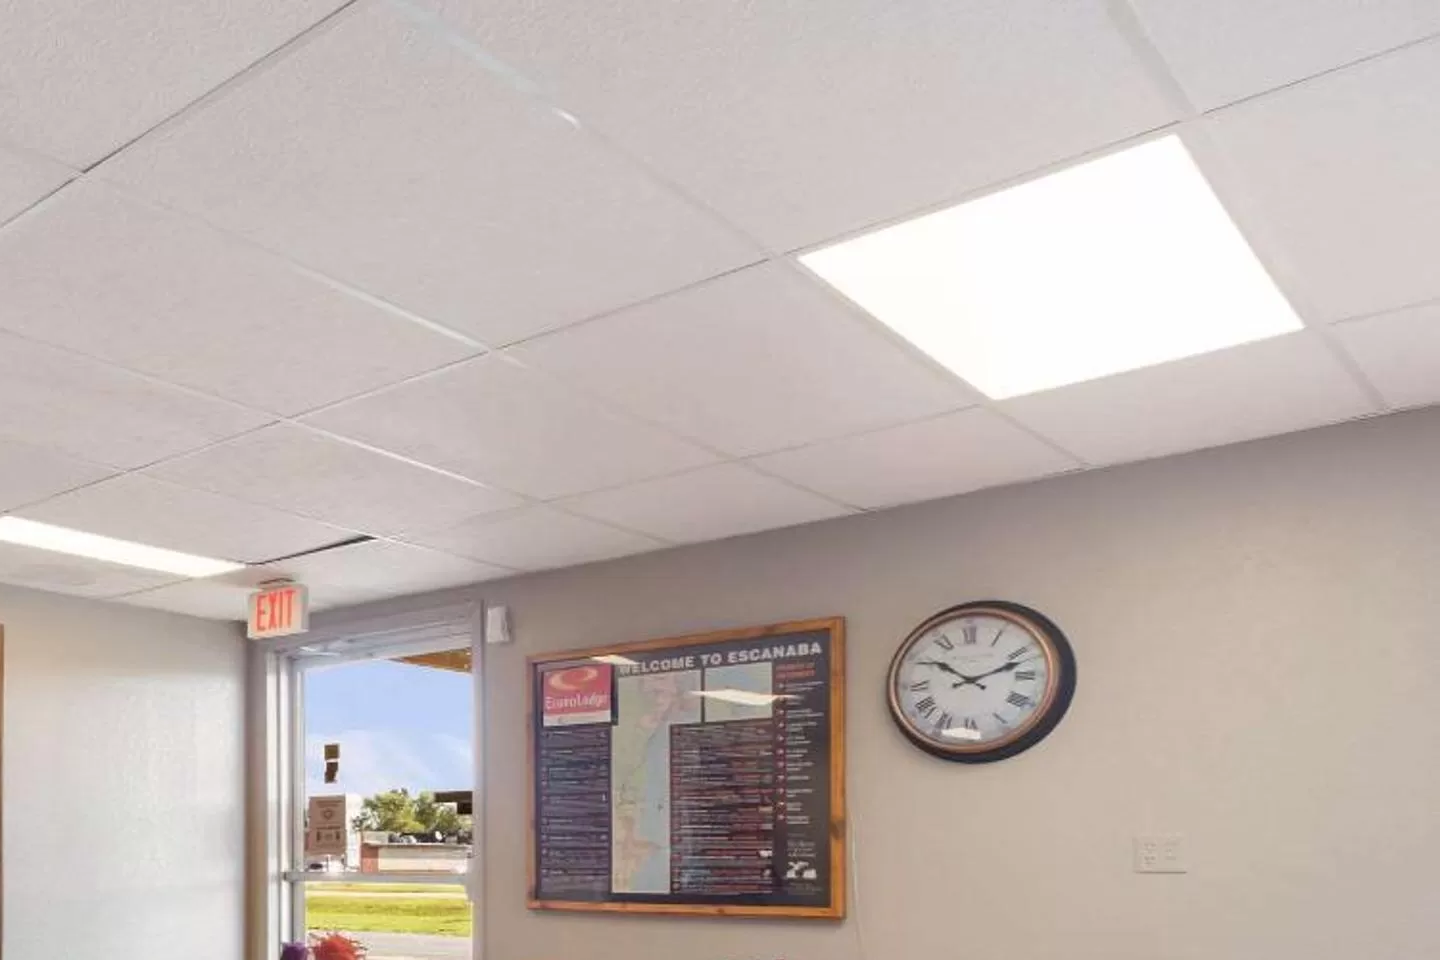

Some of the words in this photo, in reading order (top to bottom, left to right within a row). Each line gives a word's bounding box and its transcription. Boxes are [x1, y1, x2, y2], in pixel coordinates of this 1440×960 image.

[256, 590, 296, 631] EXIT
[619, 656, 695, 678] WELCOME
[700, 653, 722, 666] TO
[727, 642, 823, 663] ESCANABA
